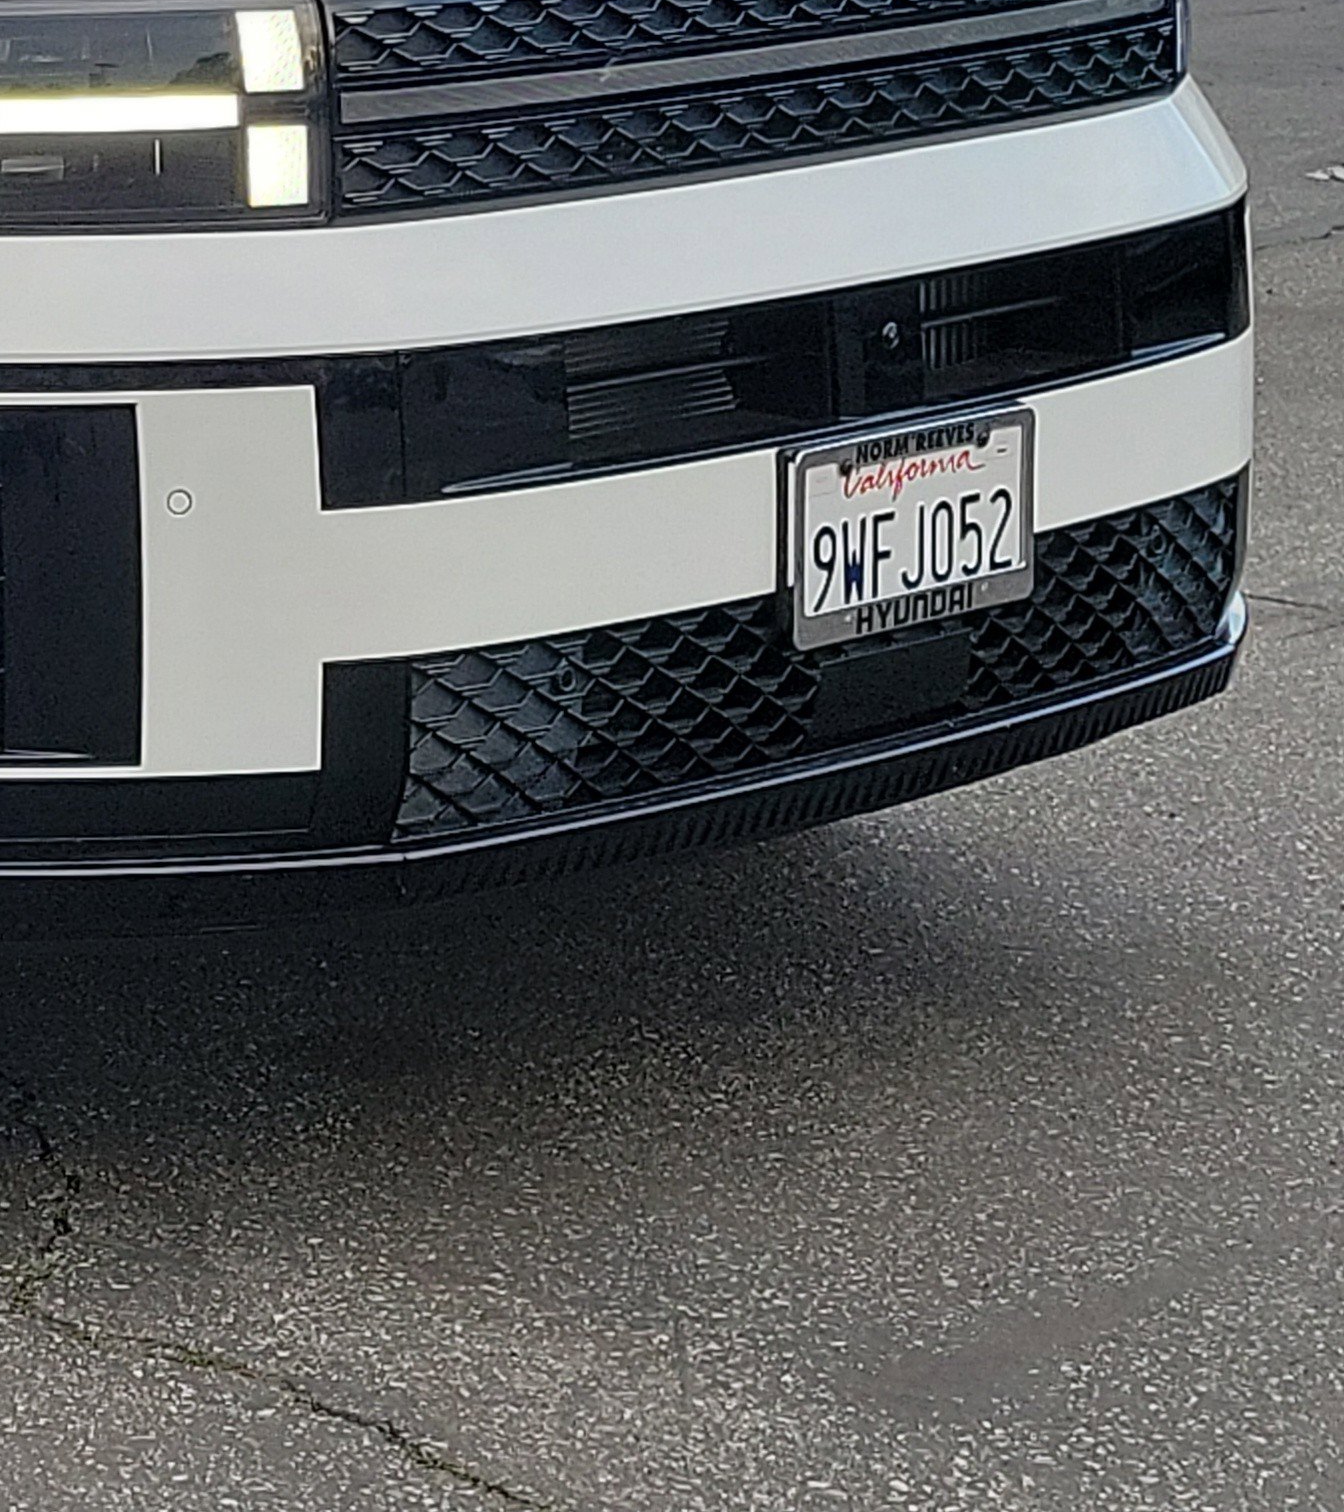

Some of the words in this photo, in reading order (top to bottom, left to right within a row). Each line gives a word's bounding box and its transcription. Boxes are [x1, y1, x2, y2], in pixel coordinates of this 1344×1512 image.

[855, 438, 909, 465] NORM
[914, 422, 975, 450] REEVES
[842, 449, 986, 502] California
[812, 487, 1013, 613] 9WFJ052
[855, 584, 974, 634] HYUNDAI
